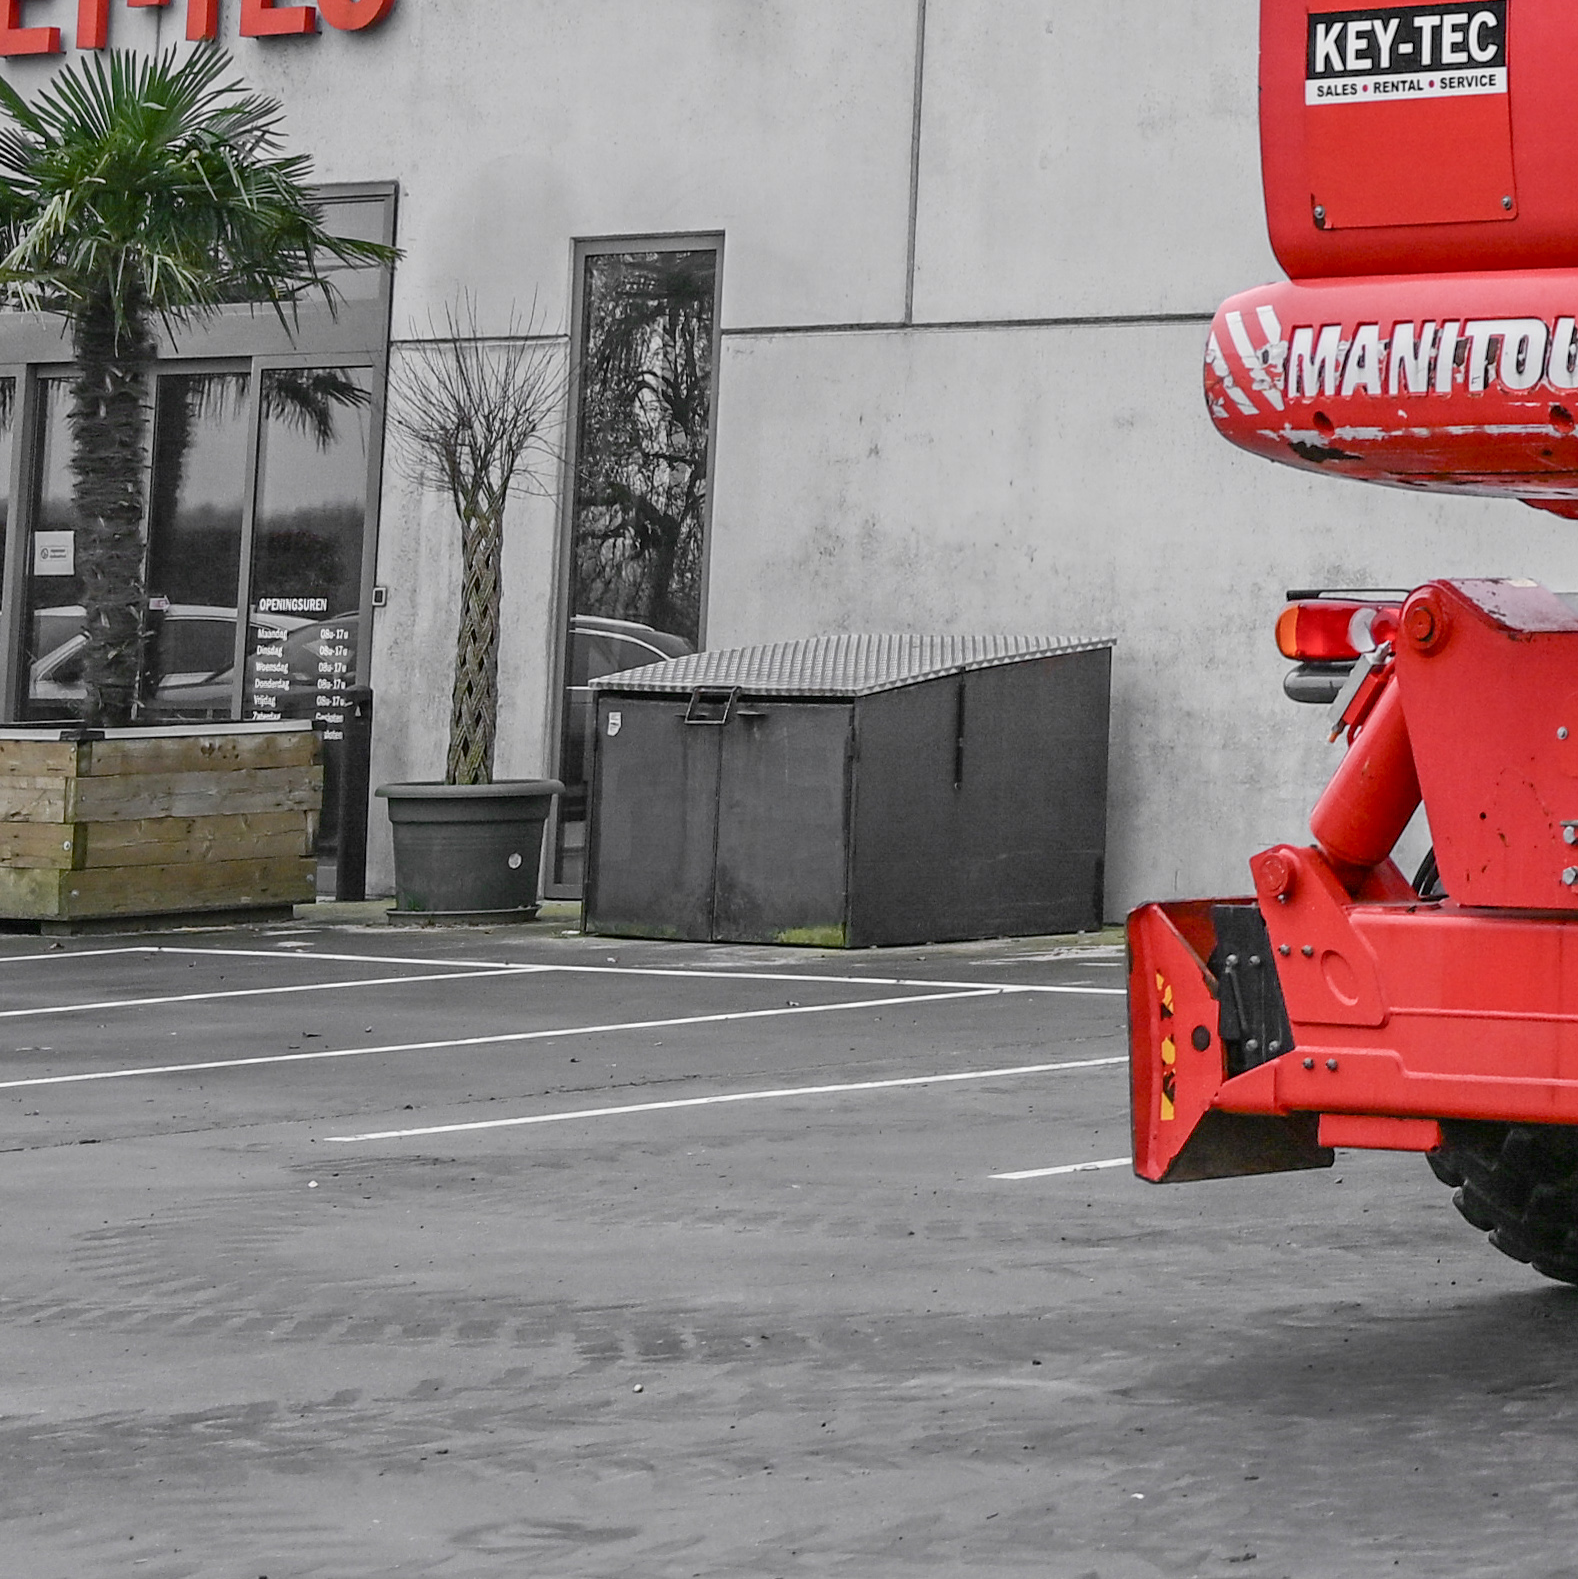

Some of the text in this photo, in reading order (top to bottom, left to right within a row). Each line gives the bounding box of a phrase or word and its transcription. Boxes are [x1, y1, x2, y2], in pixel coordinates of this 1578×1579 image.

[1314, 10, 1499, 73] KEY-TEC
[1317, 74, 1497, 98] SALES RENTAL SERVICE
[259, 598, 328, 612] OPENINGSUREN
[257, 628, 288, 641] Maandag
[256, 645, 283, 658] Dinsdag
[255, 661, 289, 674] Woensdag
[254, 678, 290, 691] Donderdag
[253, 694, 277, 708] Vrijdag
